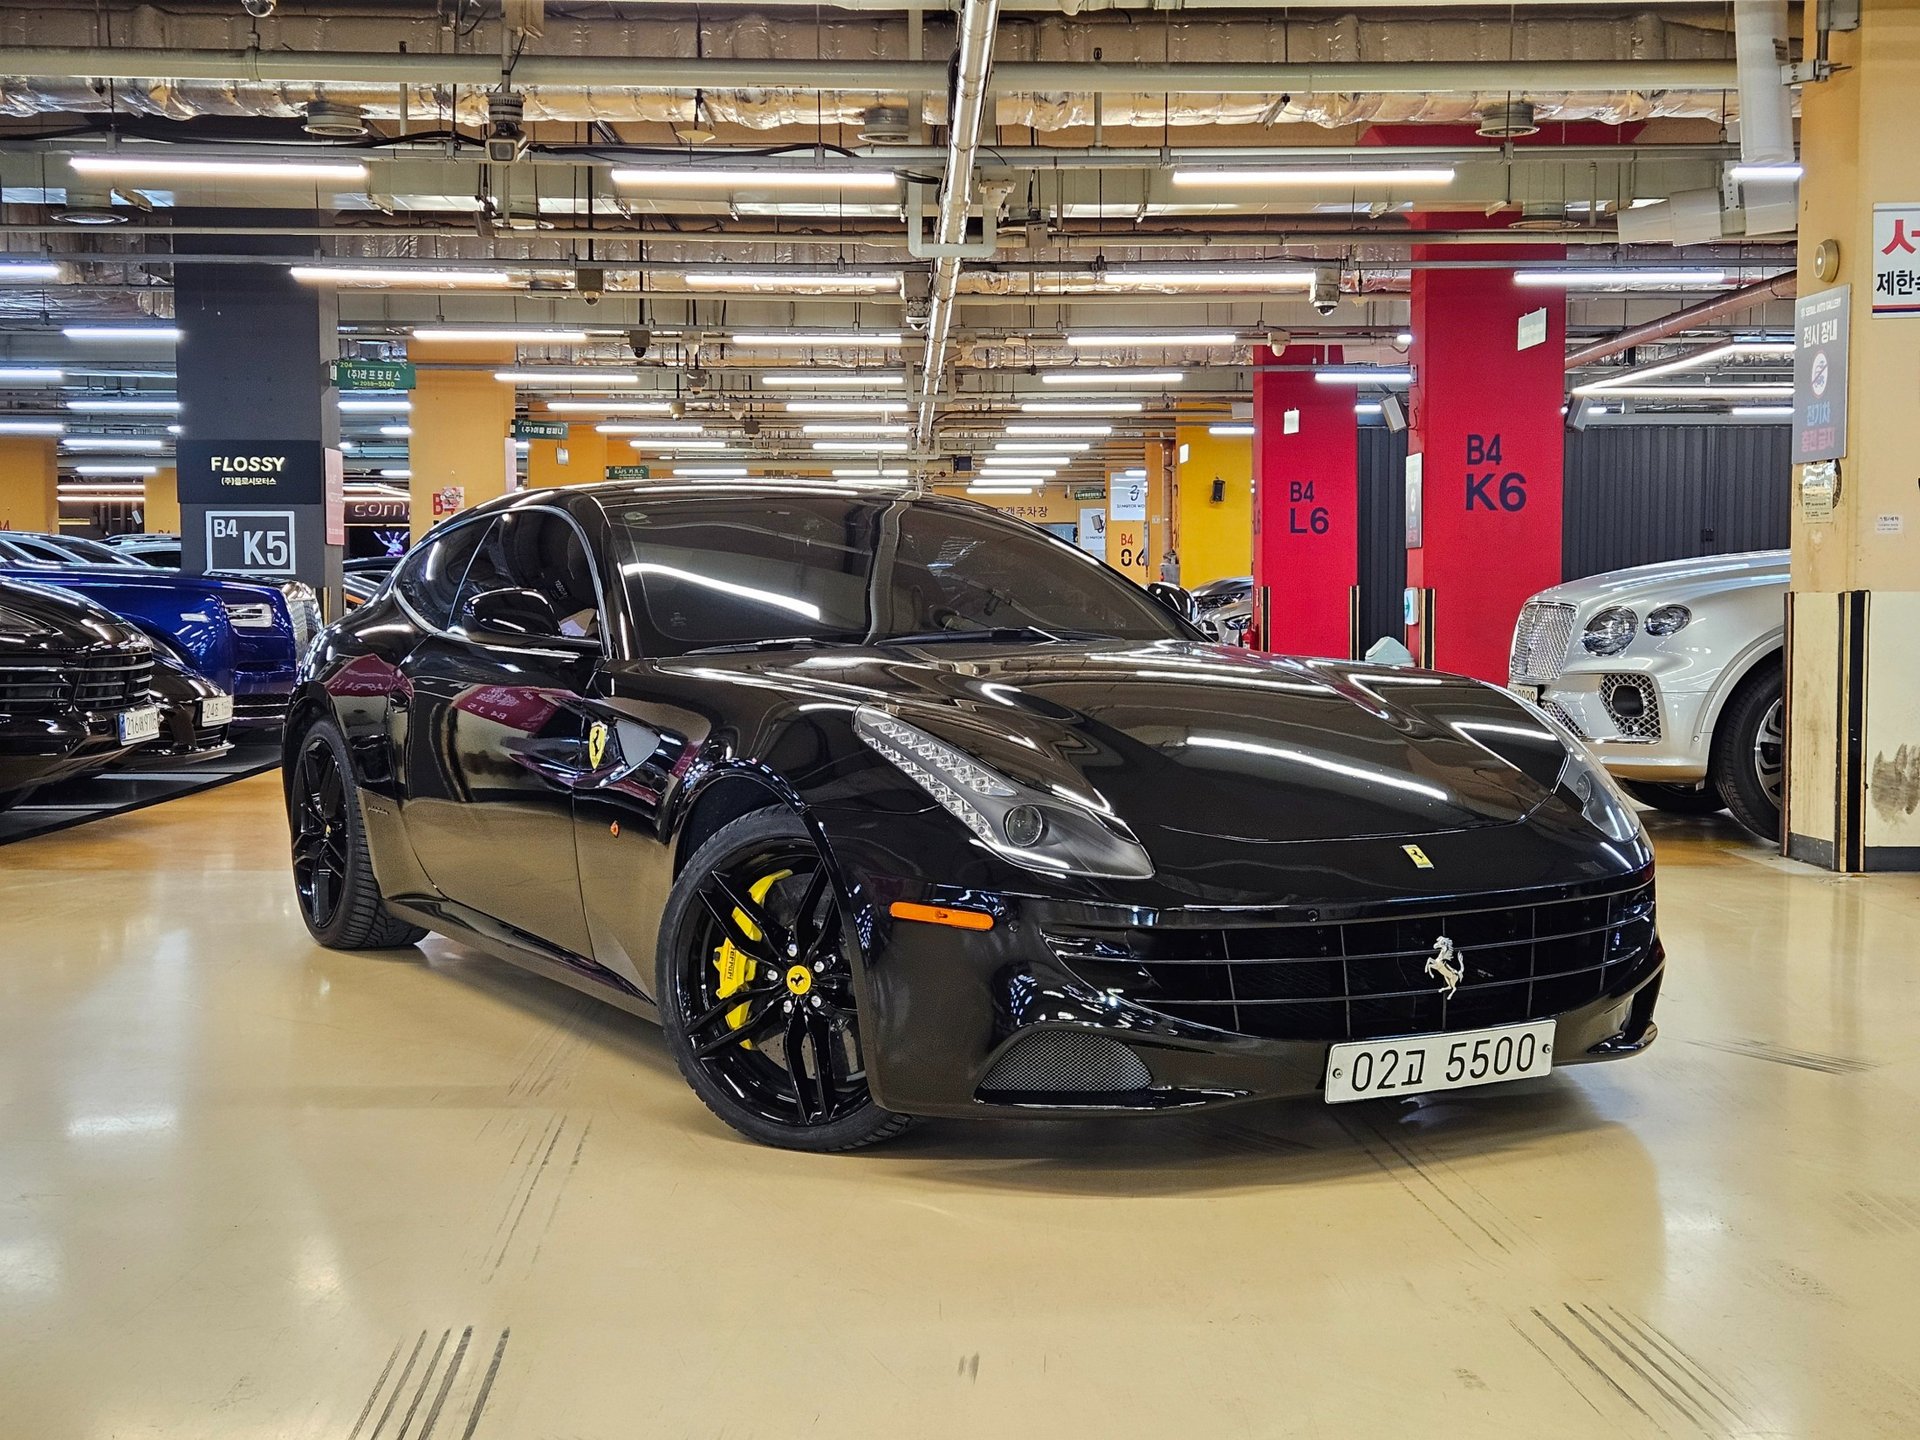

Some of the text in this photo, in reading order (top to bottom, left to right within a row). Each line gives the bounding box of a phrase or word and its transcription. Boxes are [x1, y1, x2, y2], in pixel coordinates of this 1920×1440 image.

[1466, 433, 1502, 466] B4
[210, 456, 286, 472] FLOSSY
[1290, 481, 1314, 503] B4
[1465, 472, 1527, 512] K6
[354, 501, 410, 521] com
[1289, 507, 1329, 535] L6
[213, 519, 238, 538] B4
[1120, 533, 1134, 546] B4
[243, 530, 288, 567] K5
[1445, 1032, 1536, 1083] 5500
